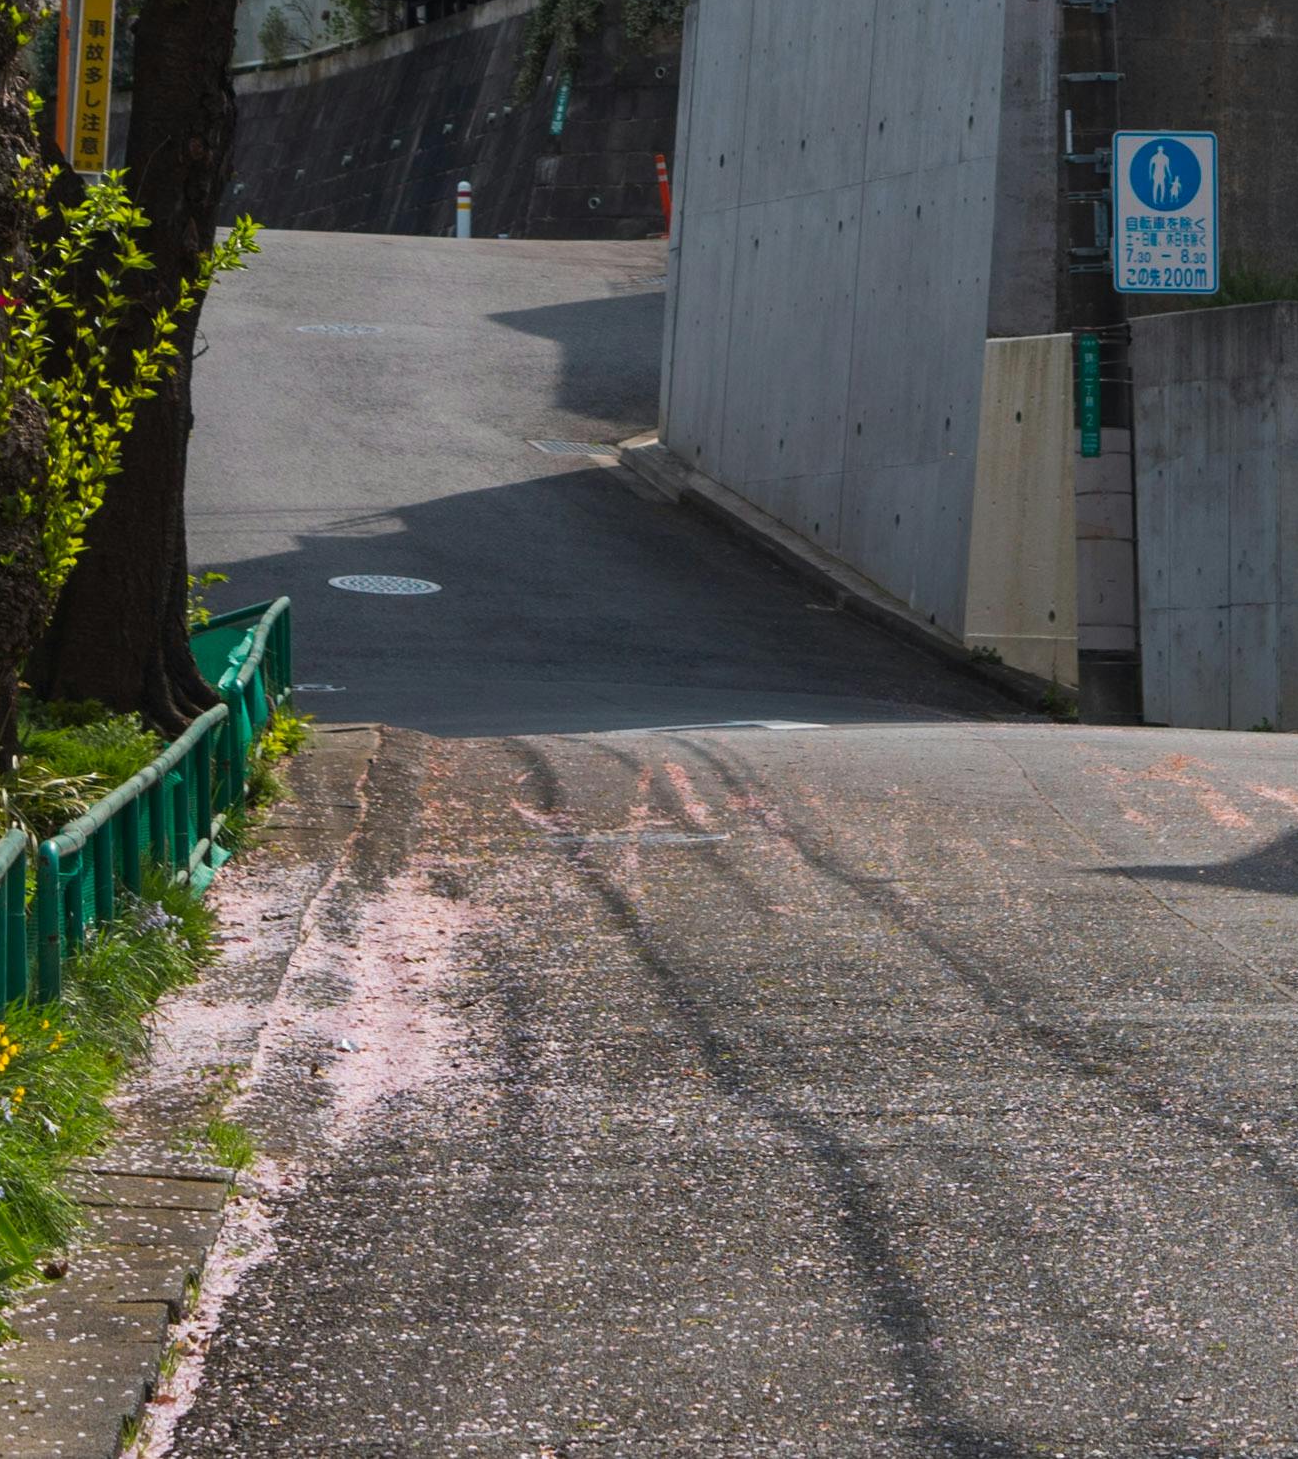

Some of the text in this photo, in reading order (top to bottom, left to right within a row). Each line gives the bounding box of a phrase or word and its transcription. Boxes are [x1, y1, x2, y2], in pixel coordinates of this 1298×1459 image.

[80, 20, 105, 155] 事故多し注意
[1126, 217, 1206, 231] 自転車を除く
